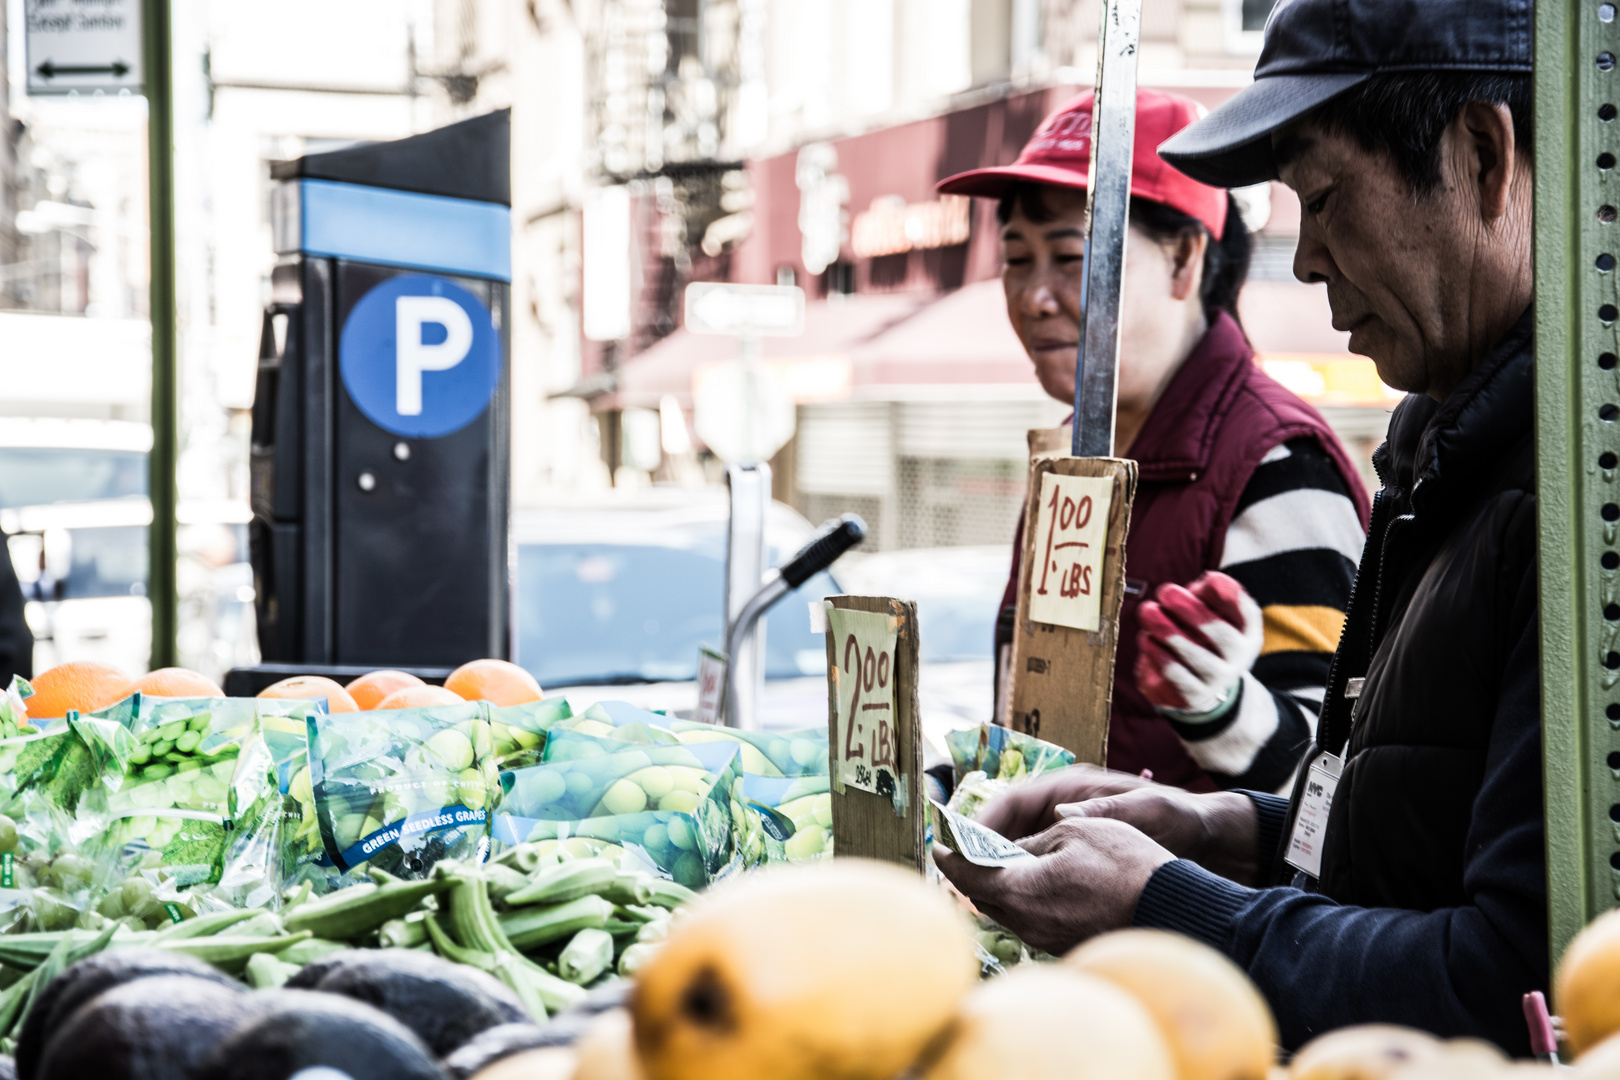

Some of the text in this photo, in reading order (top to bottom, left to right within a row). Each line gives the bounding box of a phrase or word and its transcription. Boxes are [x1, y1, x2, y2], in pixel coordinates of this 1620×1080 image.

[396, 296, 474, 416] P
[362, 828, 400, 854] GREEN
[402, 813, 454, 836] SEEDLESS
[455, 808, 486, 823] GRAPES
